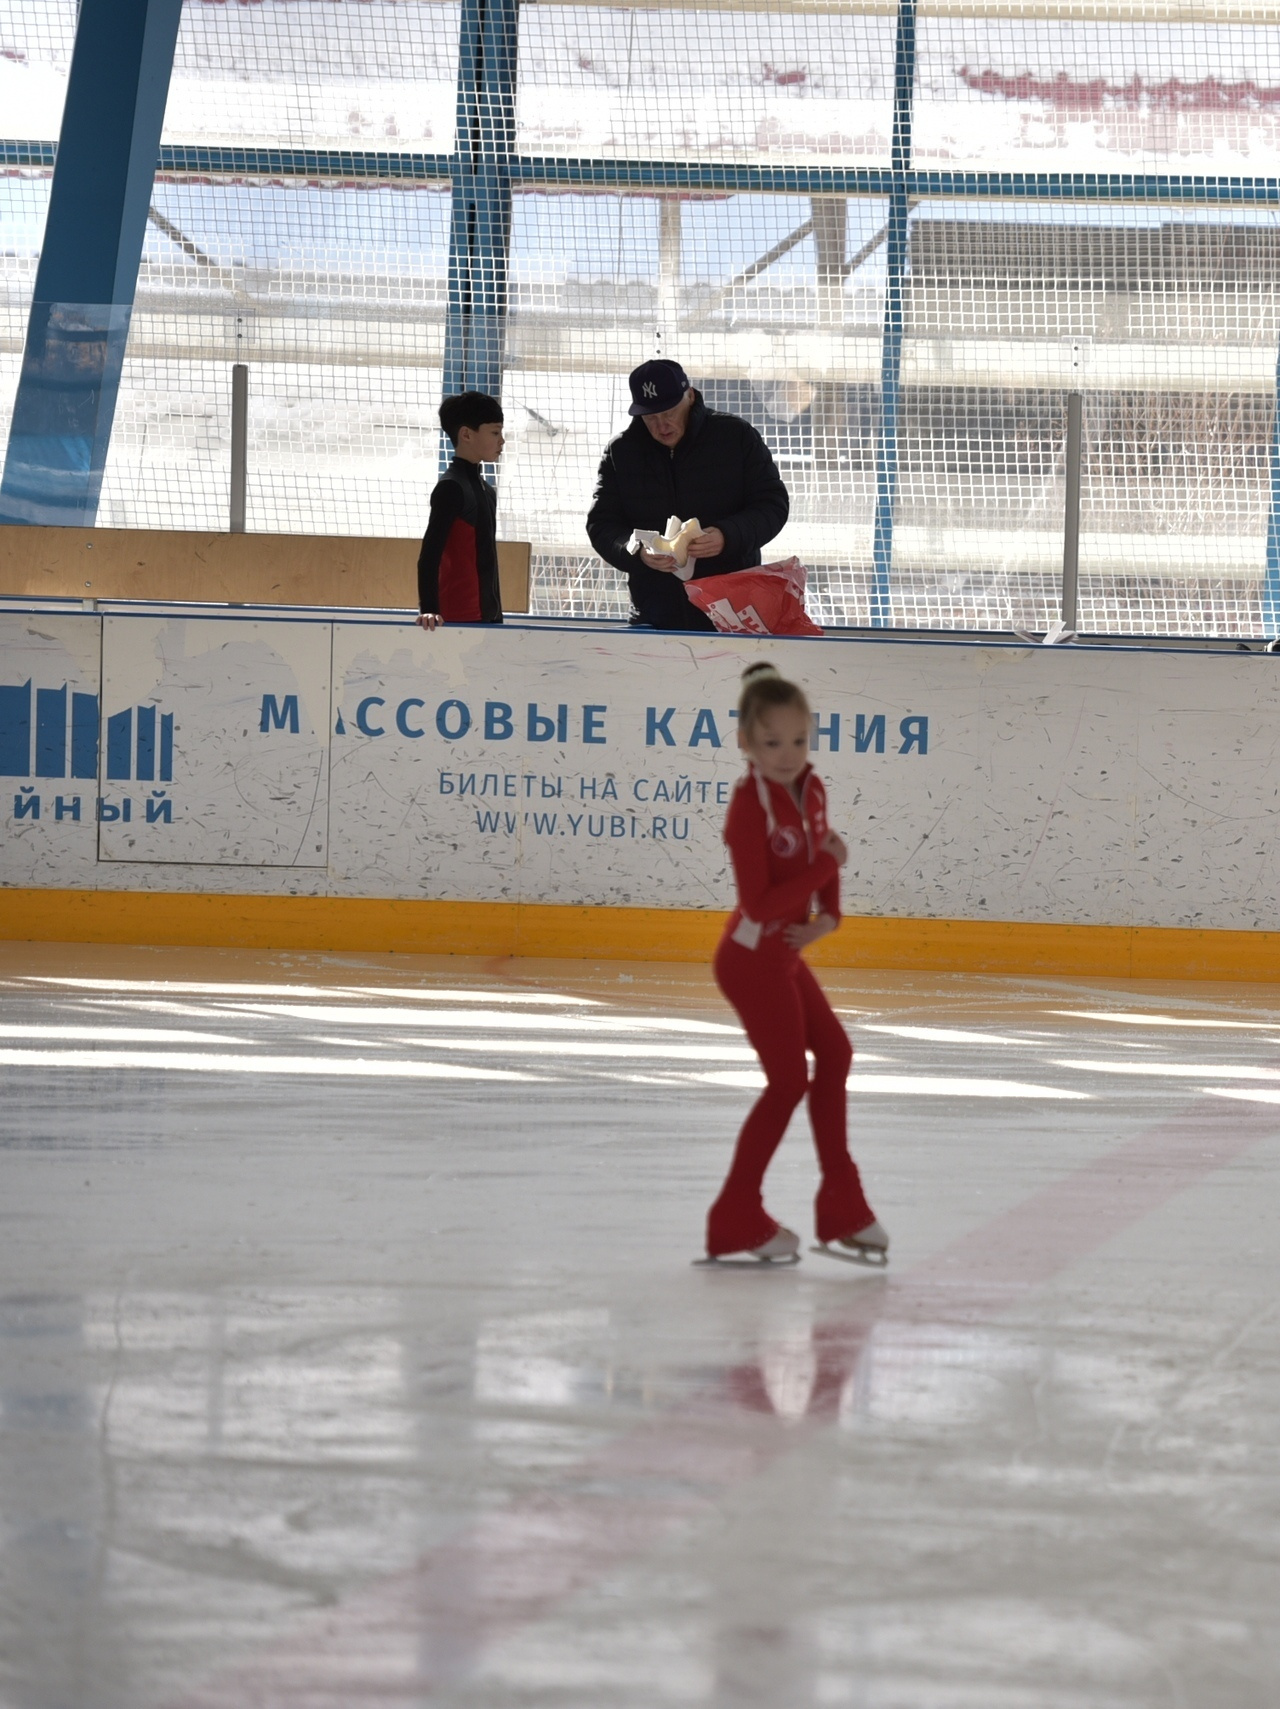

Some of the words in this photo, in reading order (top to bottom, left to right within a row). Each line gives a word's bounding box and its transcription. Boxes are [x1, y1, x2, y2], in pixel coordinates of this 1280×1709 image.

[645, 706, 930, 756] КАНИЯ
[13, 786, 174, 825] йный
[439, 772, 564, 799] БИЛЕТЫ
[580, 777, 619, 802] НА
[633, 774, 730, 805] САЙТЕ
[476, 810, 690, 841] WWW.YUBI.RU
